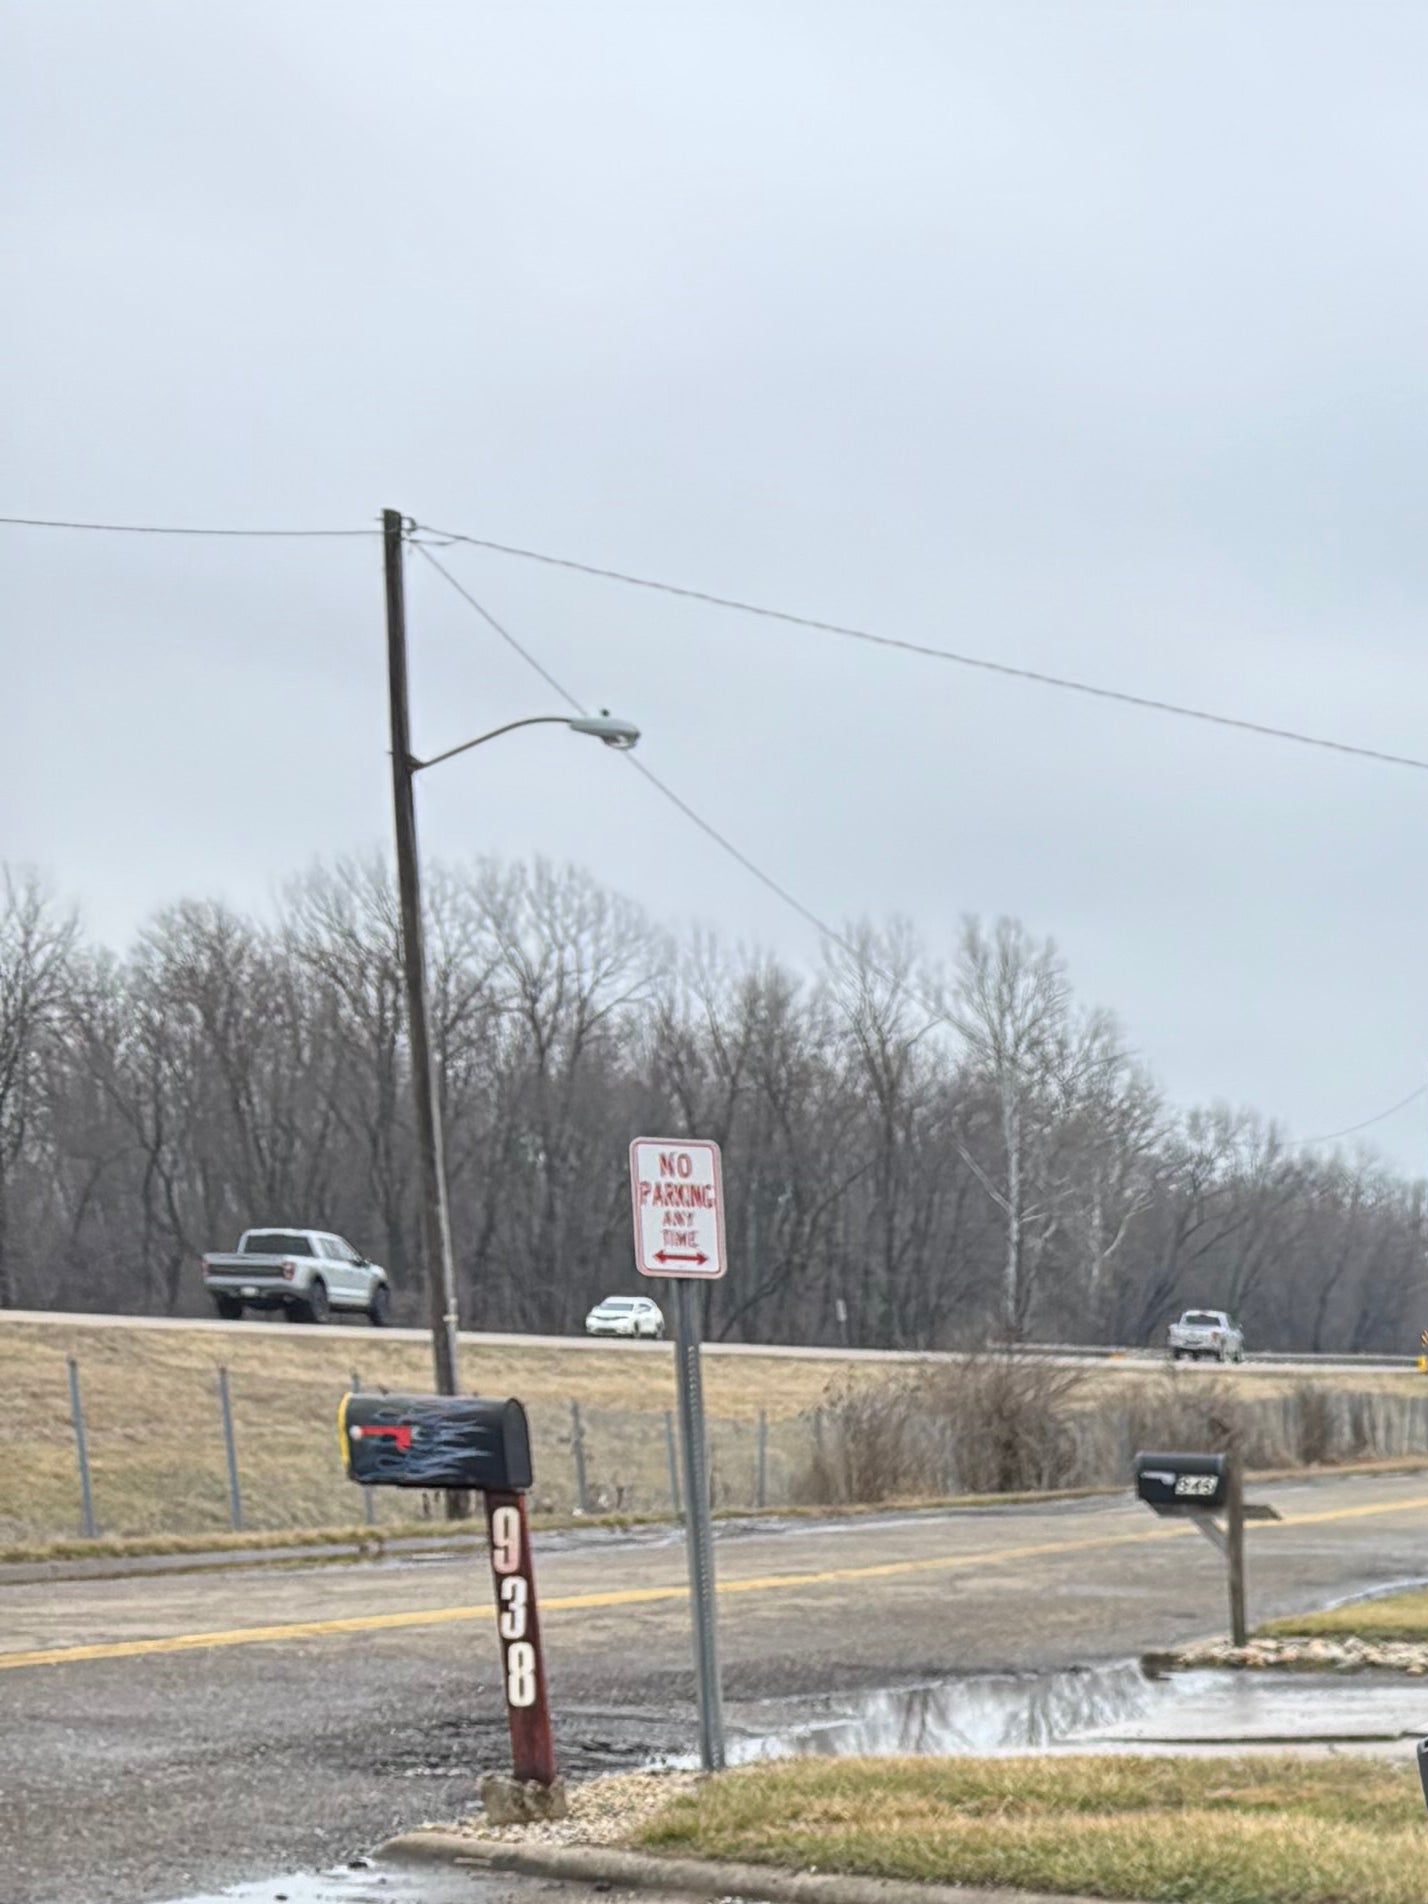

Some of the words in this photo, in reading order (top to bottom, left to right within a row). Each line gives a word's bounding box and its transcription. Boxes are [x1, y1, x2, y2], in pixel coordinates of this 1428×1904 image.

[659, 1152, 693, 1178] NO
[639, 1181, 713, 1208] PARKING
[662, 1211, 694, 1227] ANY
[661, 1229, 698, 1248] TIME
[492, 1506, 536, 1707] 938
